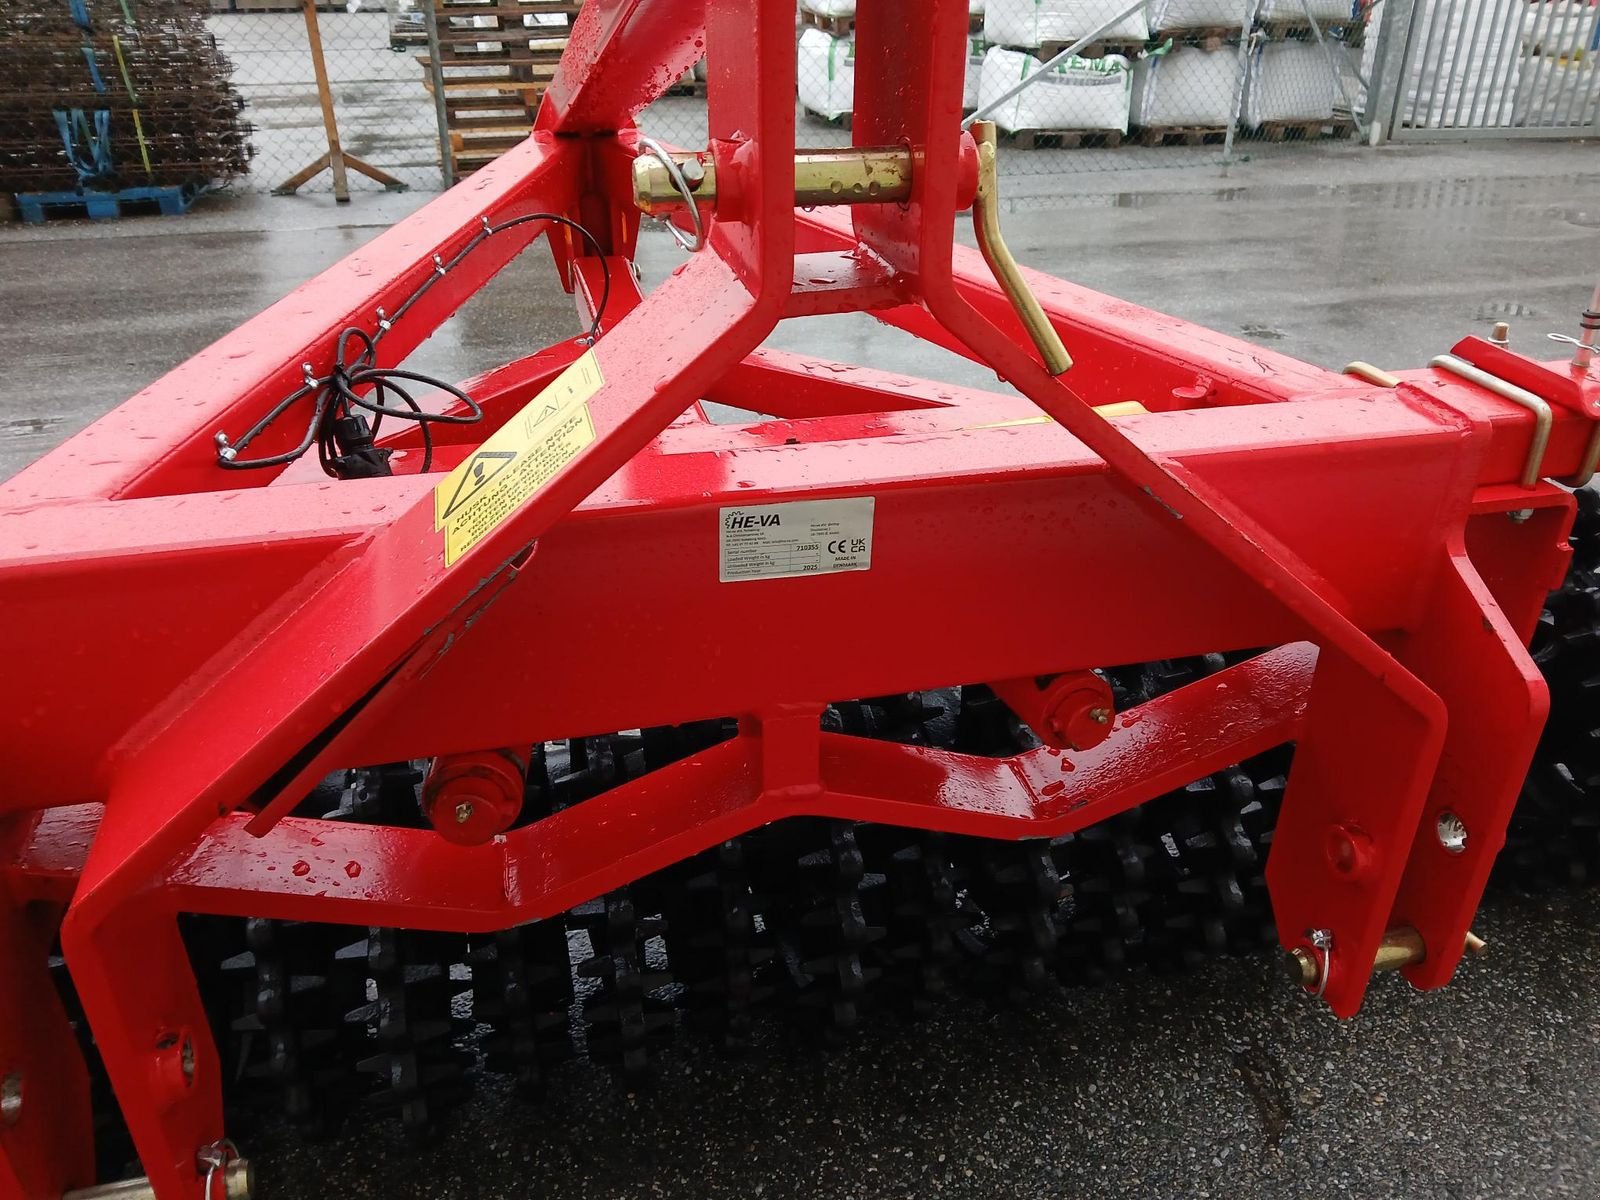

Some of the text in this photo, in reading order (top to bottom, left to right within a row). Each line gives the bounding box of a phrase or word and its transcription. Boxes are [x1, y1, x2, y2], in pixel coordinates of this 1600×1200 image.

[452, 483, 508, 535] ACHTUNG
[519, 417, 583, 477] ATTENTION
[456, 494, 488, 524] HUSK
[498, 446, 541, 487] PLEASE
[545, 417, 575, 445] NOTE
[471, 503, 508, 537] BOLZEN
[730, 513, 780, 528] HE-VA
[827, 539, 846, 554] CE
